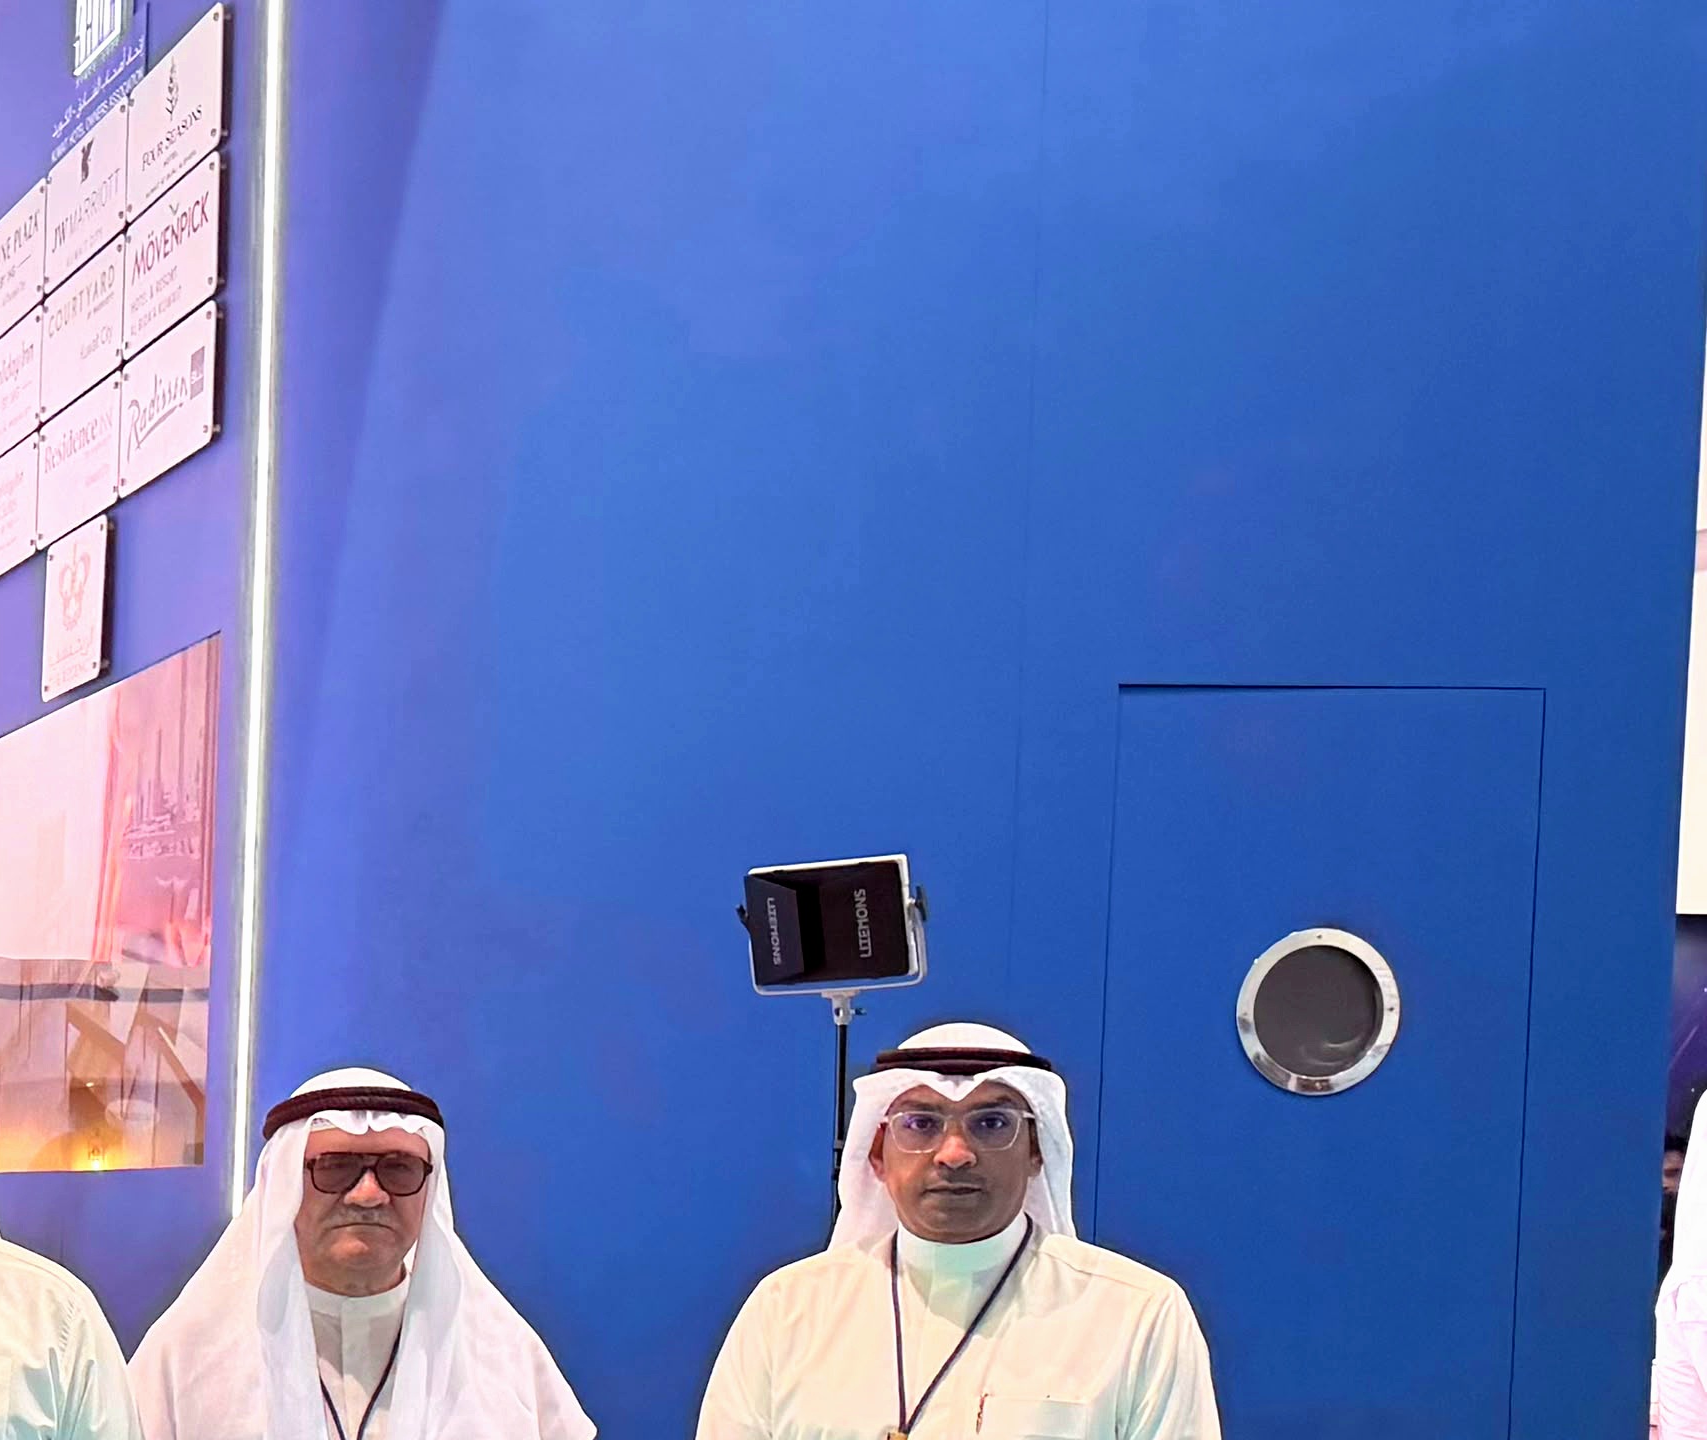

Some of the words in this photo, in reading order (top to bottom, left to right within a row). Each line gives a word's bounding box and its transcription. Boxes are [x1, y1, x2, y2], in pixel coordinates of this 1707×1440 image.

[142, 141, 164, 172] FOUR
[164, 104, 203, 150] SEASONS
[12, 208, 41, 254] PLAZA
[51, 221, 66, 254] JW
[66, 167, 121, 235] MARRIOTT
[130, 190, 210, 287] MÖVENPICK
[47, 264, 115, 339] COURTYARD
[44, 419, 98, 474] Residence
[126, 373, 188, 464] Radisson
